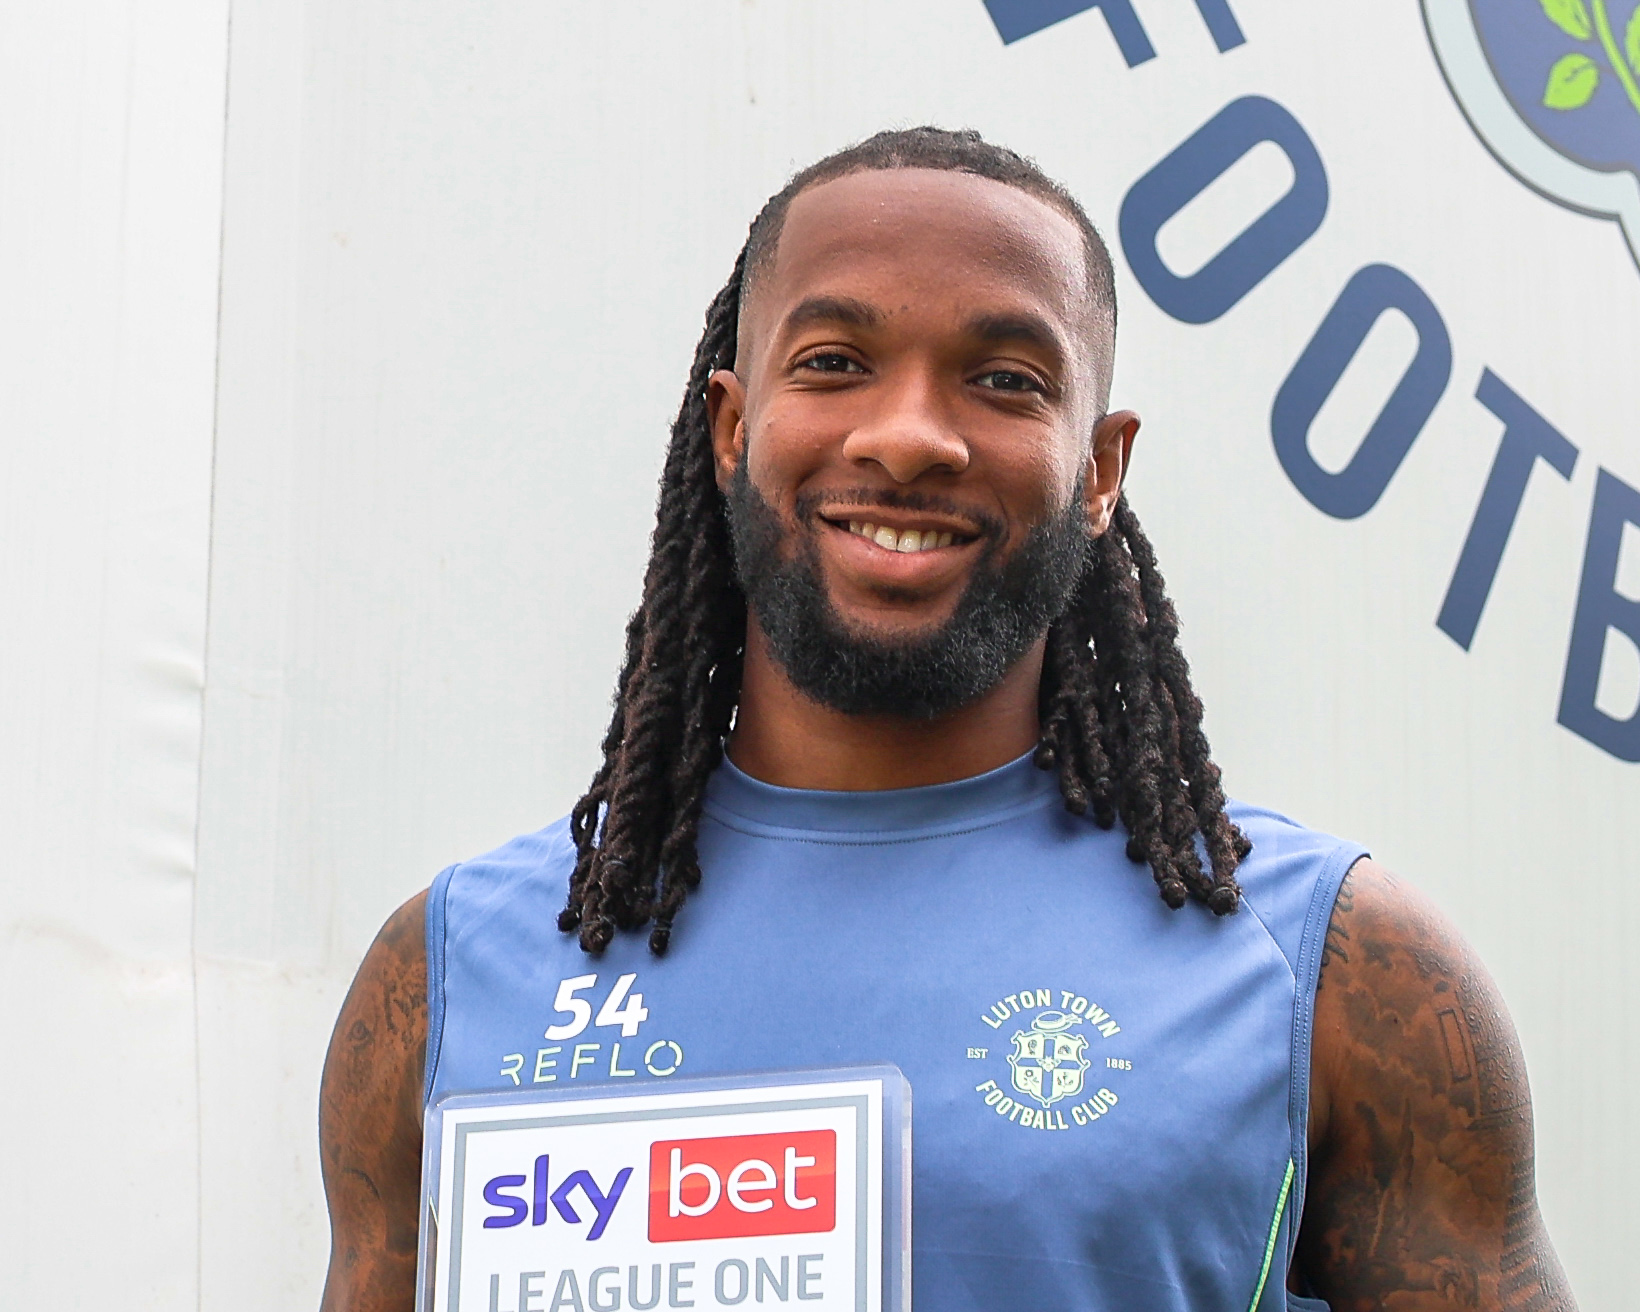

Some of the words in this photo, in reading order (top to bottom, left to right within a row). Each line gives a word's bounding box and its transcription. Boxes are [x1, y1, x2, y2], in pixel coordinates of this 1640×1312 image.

[544, 972, 649, 1041] 54
[981, 989, 1051, 1029] LUTON
[1061, 991, 1121, 1038] TOWN
[500, 1040, 684, 1086] REFLO
[967, 1047, 989, 1059] EST
[1106, 1057, 1132, 1071] 1885
[976, 1080, 1069, 1130] FOOTBALL
[1071, 1088, 1119, 1126] CLUB
[482, 1153, 634, 1241] sky
[668, 1146, 818, 1218] bet
[714, 1253, 824, 1306] ONE
